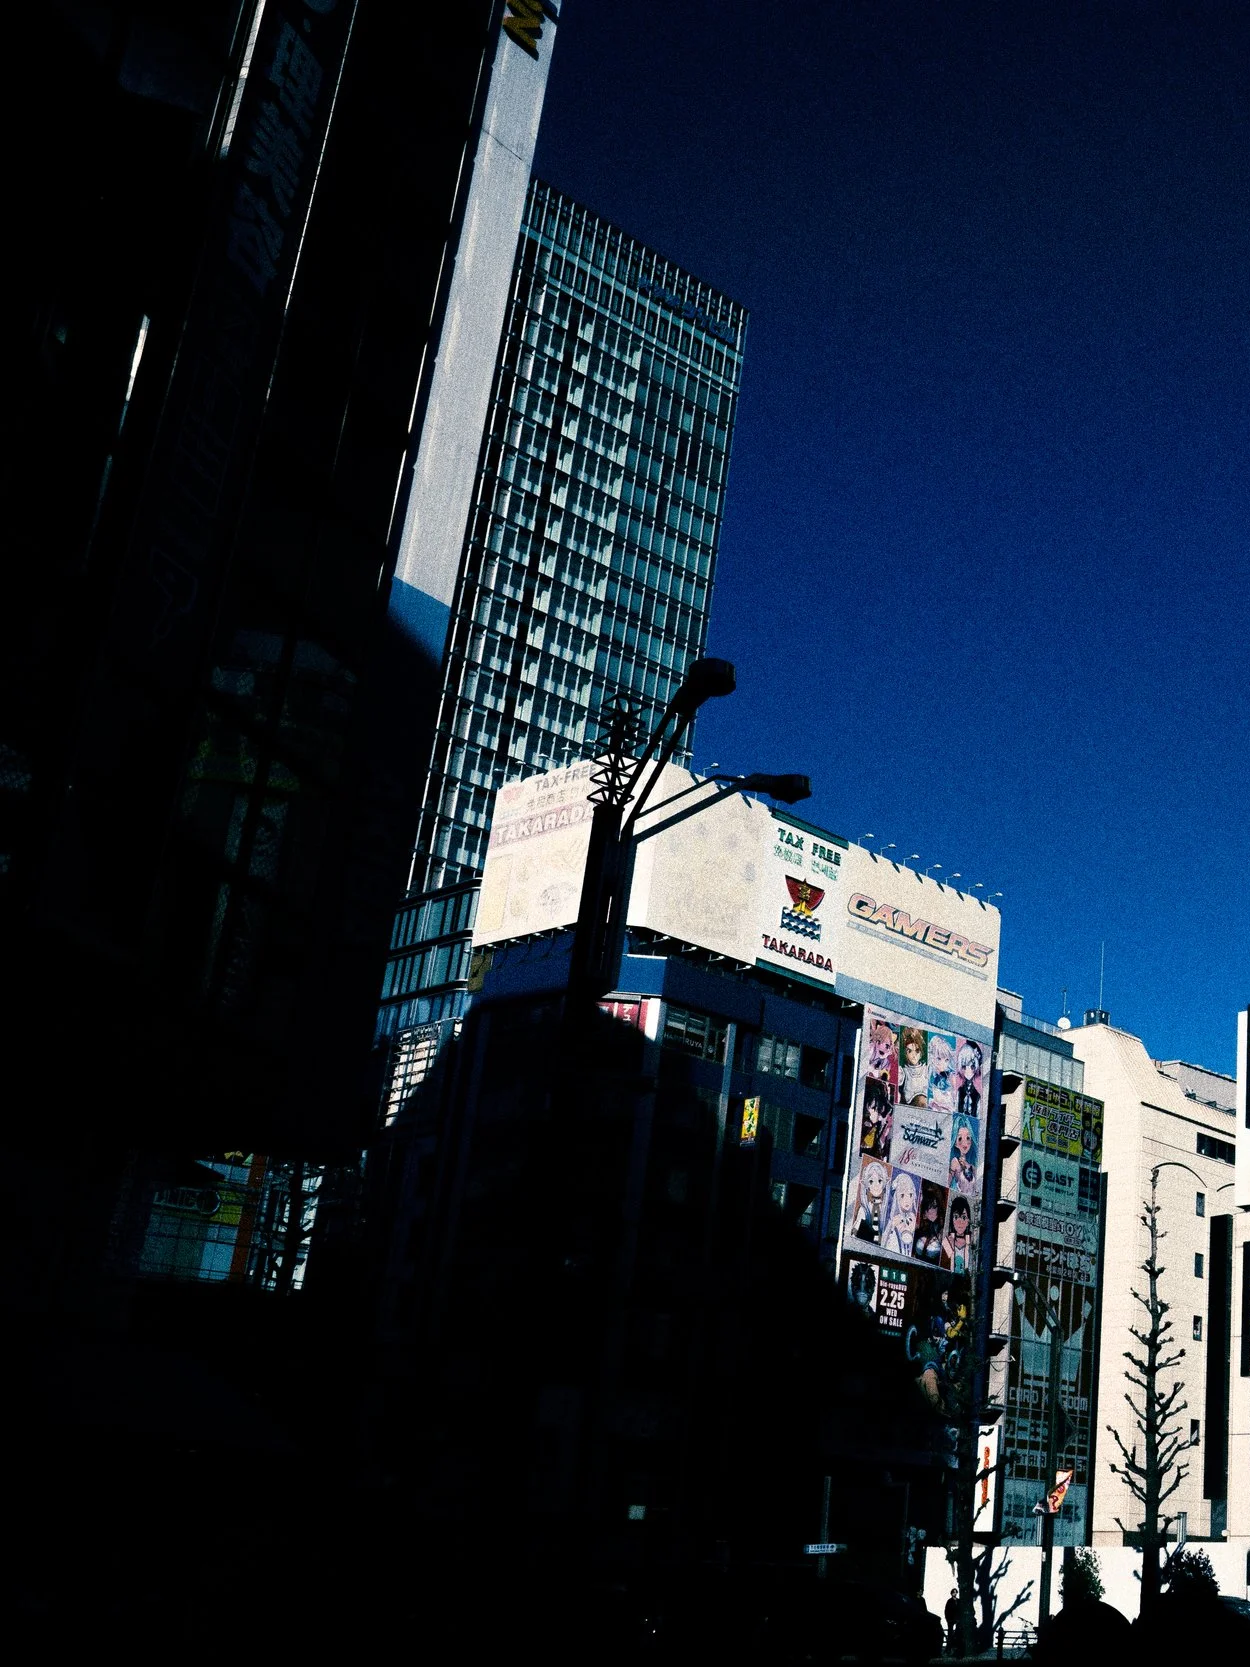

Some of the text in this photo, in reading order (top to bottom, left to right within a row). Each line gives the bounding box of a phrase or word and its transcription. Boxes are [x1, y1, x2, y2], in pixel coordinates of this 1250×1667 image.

[534, 764, 598, 793] TAX-FREE
[493, 804, 596, 847] TAKARADA
[777, 827, 842, 866] TAX FREE
[847, 892, 995, 968] GAMERS
[761, 934, 834, 973] TAKARADA
[879, 1288, 906, 1310] 2.25
[889, 1317, 903, 1328] SALE
